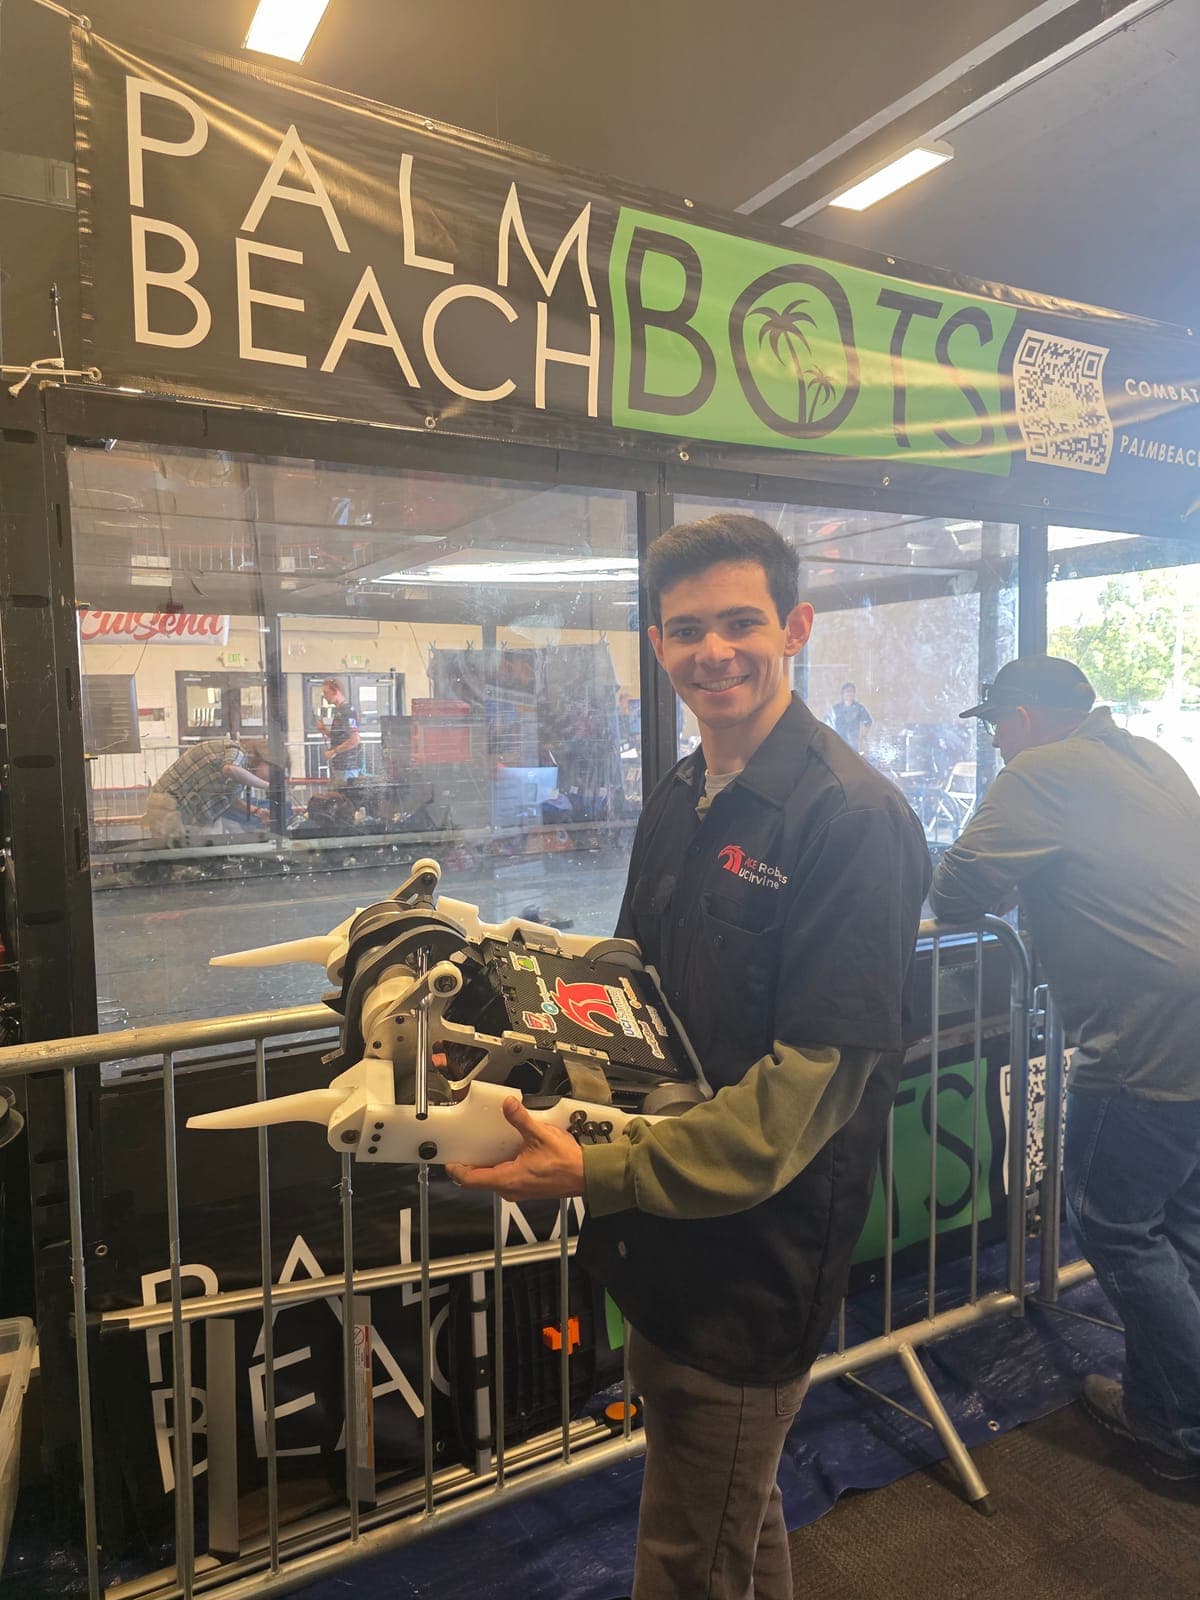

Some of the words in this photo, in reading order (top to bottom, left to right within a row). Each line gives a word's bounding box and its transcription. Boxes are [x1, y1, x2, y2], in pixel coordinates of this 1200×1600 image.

[125, 75, 597, 308] PALM
[131, 214, 600, 418] BEACH
[625, 225, 994, 459] BOTS
[1124, 377, 1200, 404] COMBAT
